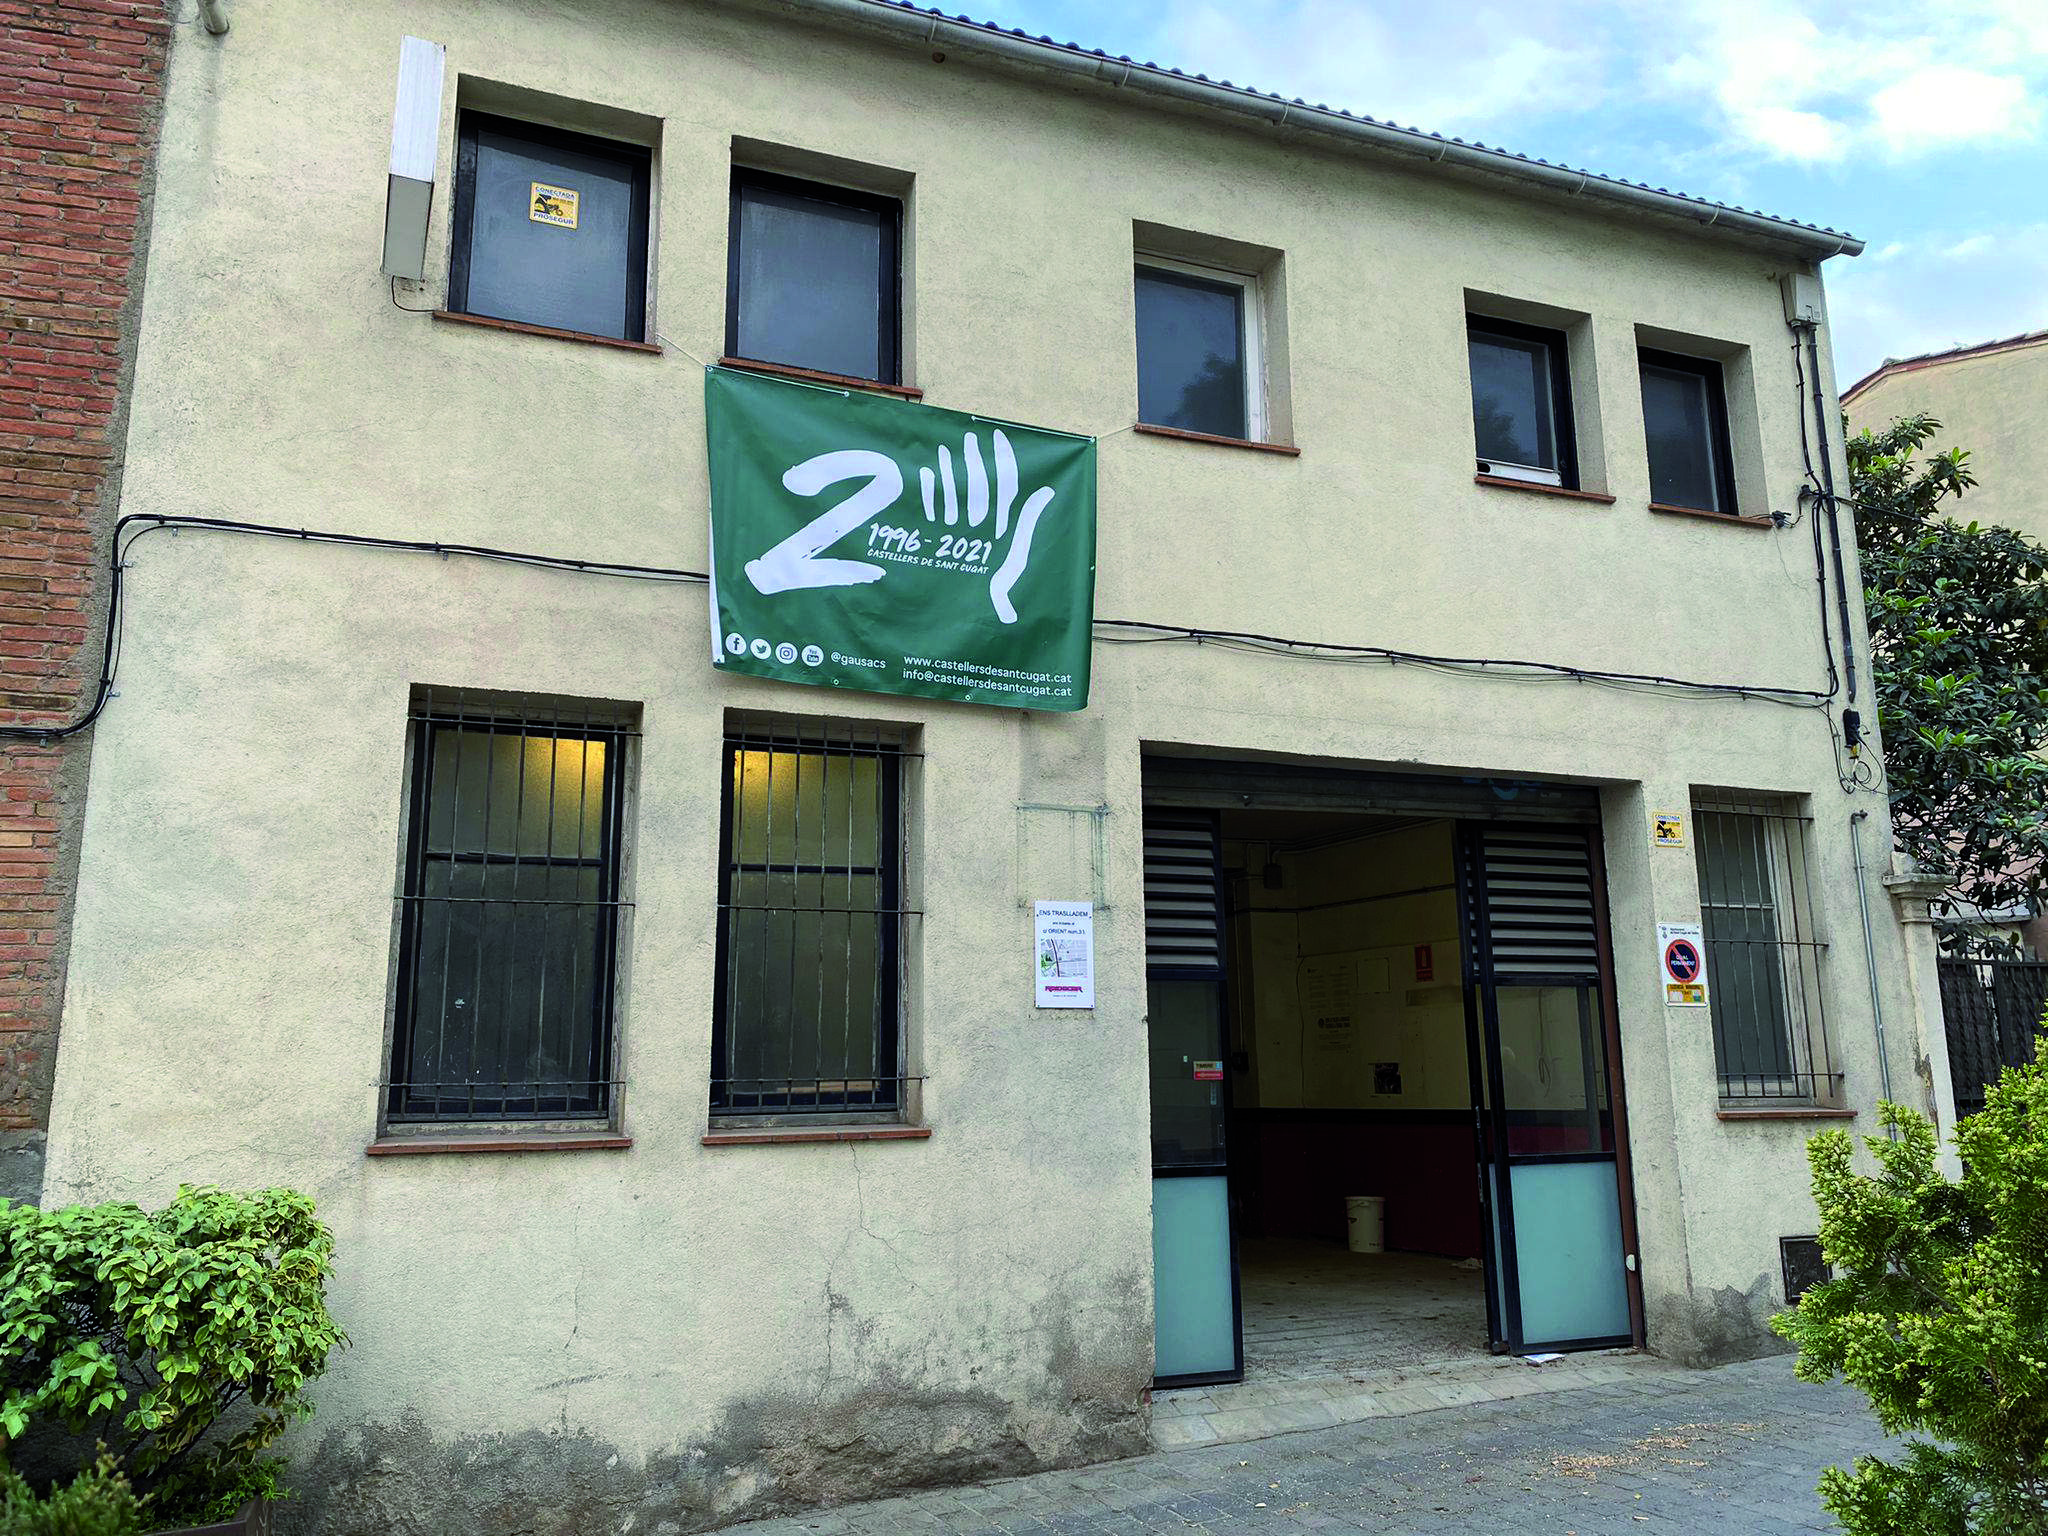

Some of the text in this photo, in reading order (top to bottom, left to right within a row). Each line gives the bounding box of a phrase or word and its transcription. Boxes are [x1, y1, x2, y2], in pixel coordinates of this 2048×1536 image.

[535, 186, 575, 200] CONECTADA
[533, 212, 574, 225] PROSEGUR
[868, 522, 921, 552] 1996
[935, 534, 992, 565] 2021
[867, 548, 989, 575] CASTELLERS DE SANT CUGAT
[830, 651, 886, 669] @gausacs
[903, 656, 1073, 684] www.castellersdesantcugat.cat
[902, 668, 1073, 697] info@castellersdesantcugat.cat
